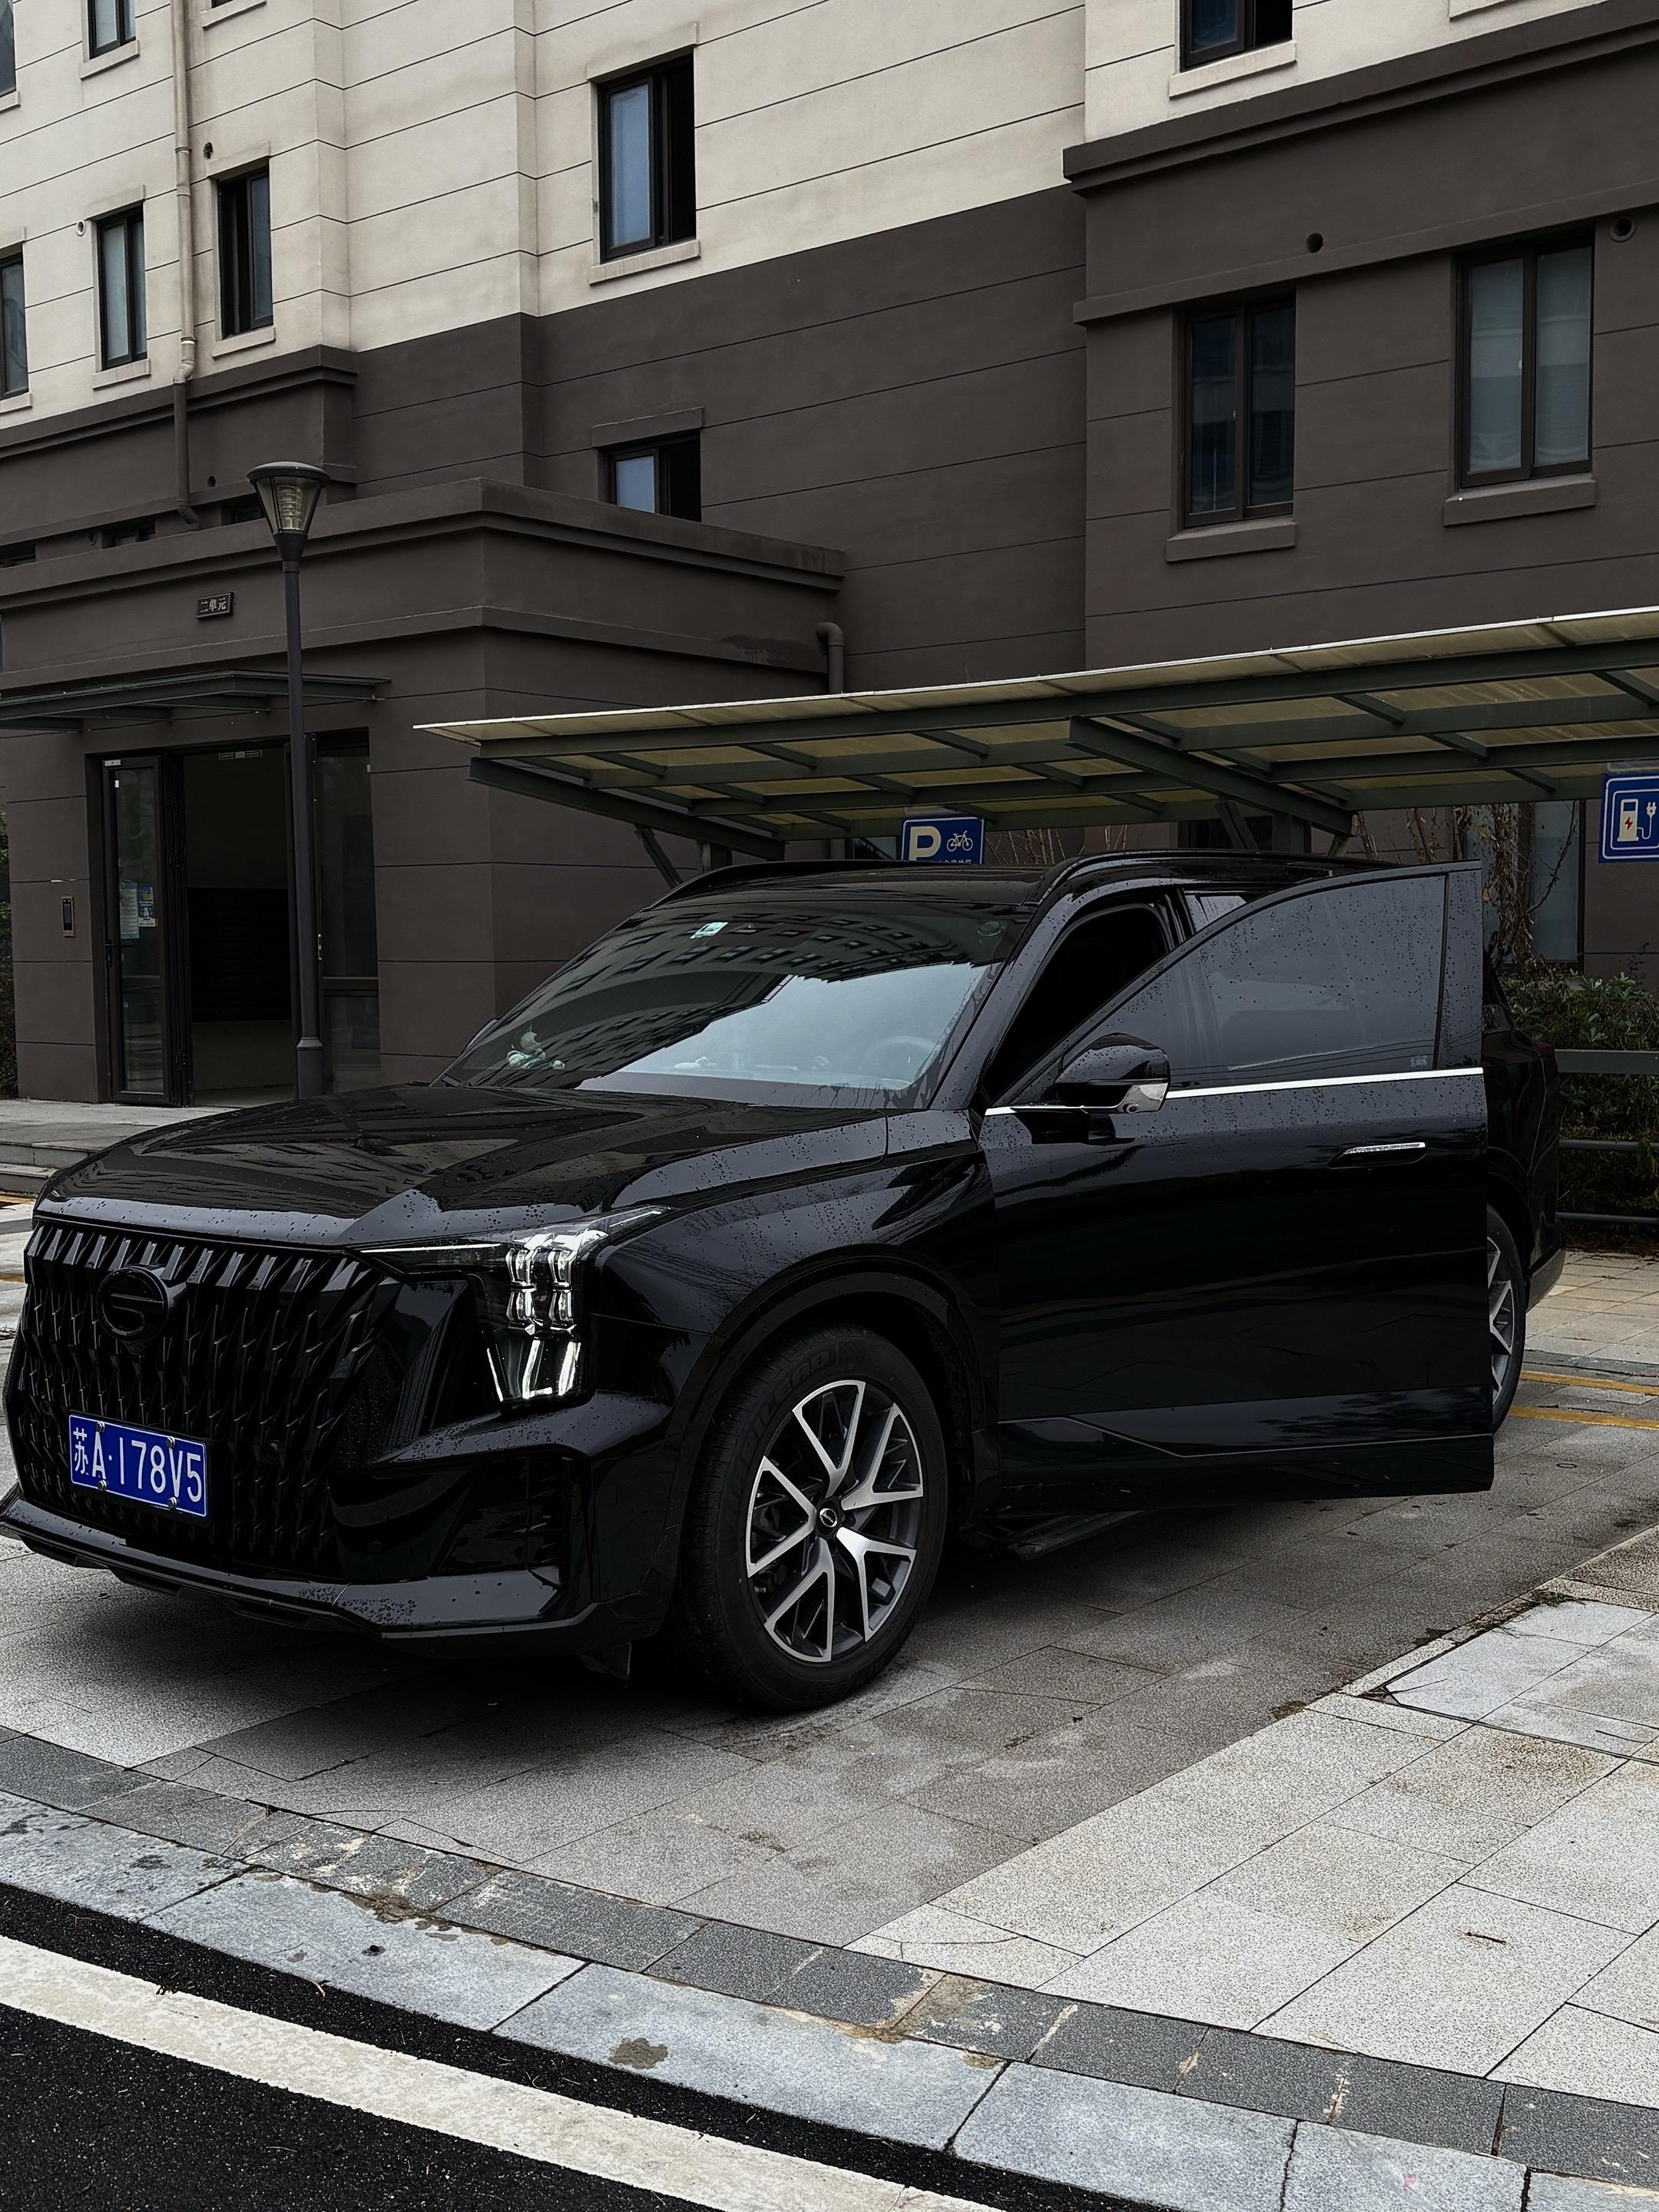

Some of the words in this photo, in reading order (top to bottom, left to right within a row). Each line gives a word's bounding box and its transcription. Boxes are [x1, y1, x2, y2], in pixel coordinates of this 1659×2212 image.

[200, 597, 227, 613] 二单元
[909, 826, 942, 861] P
